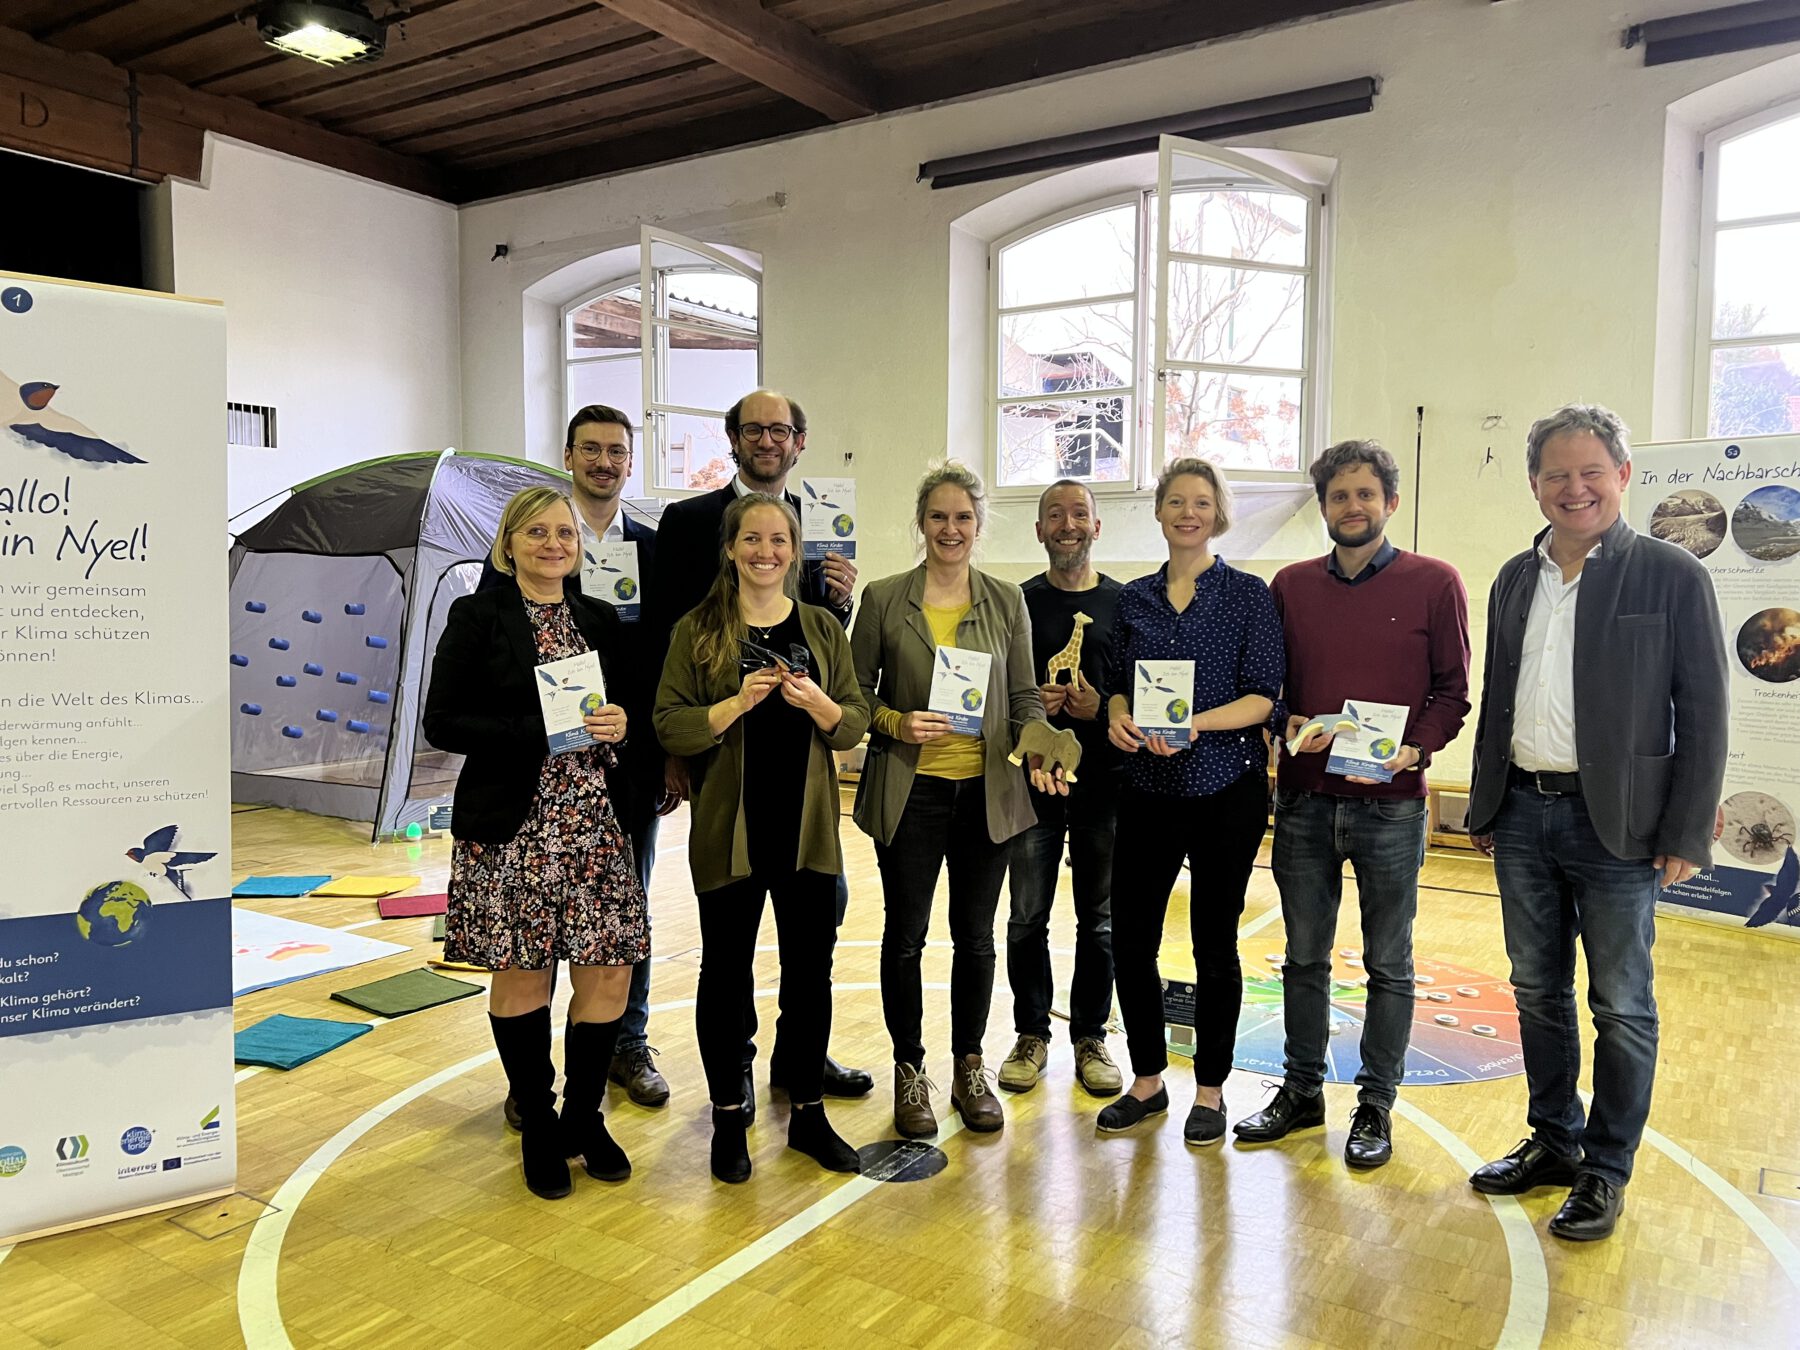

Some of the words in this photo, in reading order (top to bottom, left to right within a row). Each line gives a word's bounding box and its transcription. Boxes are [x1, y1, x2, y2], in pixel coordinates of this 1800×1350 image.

[20, 91, 49, 128] D
[12, 294, 21, 307] 1
[1641, 470, 1658, 485] In
[1667, 469, 1694, 484] der
[56, 519, 148, 580] Nyel!
[11, 581, 40, 595] wir
[46, 583, 147, 601] gemeinsam
[10, 603, 44, 617] und
[50, 604, 145, 622] entdecken,
[16, 625, 68, 640] Klima
[74, 626, 150, 641] schützen
[18, 692, 45, 707] die
[51, 691, 94, 706] Welt
[100, 691, 128, 706] des
[135, 690, 204, 706] Klimas...
[16, 751, 44, 762] über
[48, 750, 68, 761] die
[72, 749, 123, 763] Energie,
[22, 781, 55, 796] Spaß
[58, 784, 72, 792] es
[75, 779, 119, 792] macht,
[123, 778, 170, 789] unseren
[63, 794, 132, 807] Ressourcen
[136, 794, 150, 803] zu
[153, 789, 209, 802] schützen!
[16, 952, 59, 967] schon?
[0, 994, 39, 1008] Klima
[42, 986, 92, 1006] gehört?
[32, 1006, 70, 1019] Klima
[74, 996, 141, 1014] verändert?
